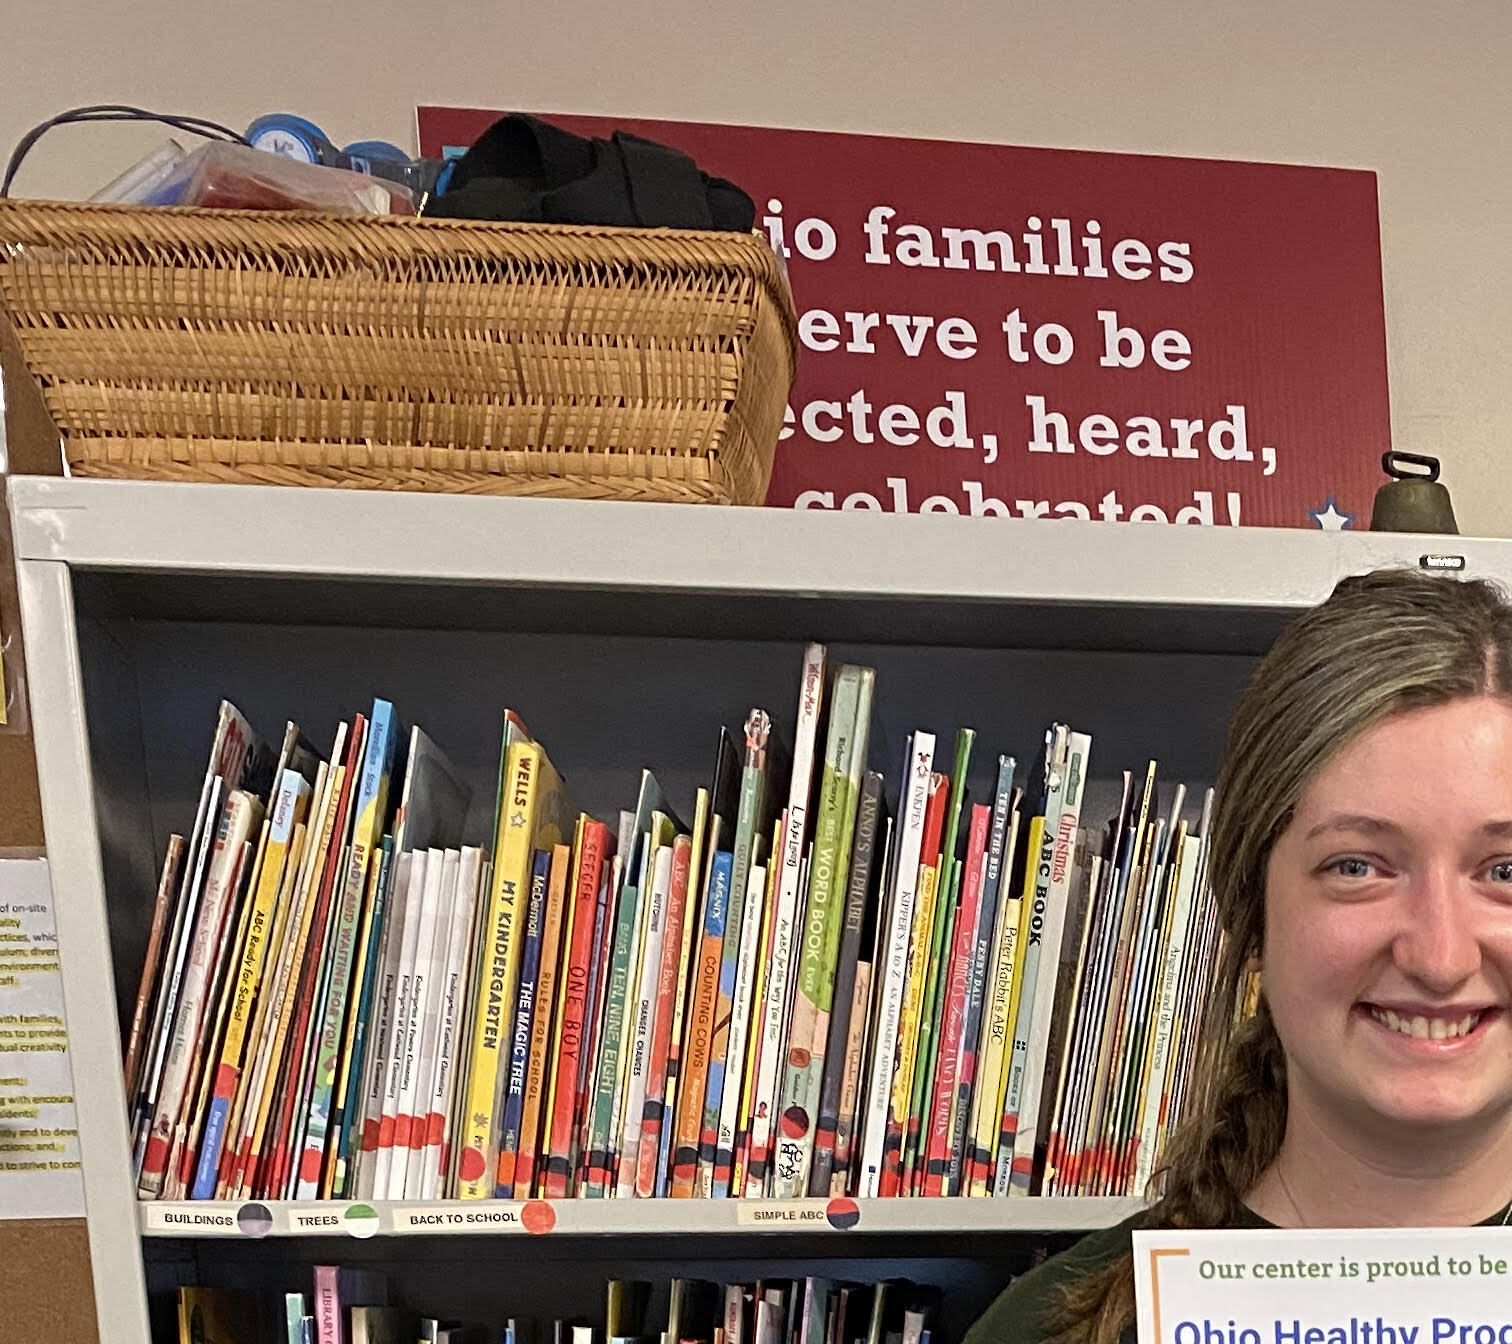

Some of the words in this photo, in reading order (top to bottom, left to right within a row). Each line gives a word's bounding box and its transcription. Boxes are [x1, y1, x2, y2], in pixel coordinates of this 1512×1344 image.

[763, 200, 837, 261] io
[865, 207, 1193, 284] families
[798, 308, 977, 360] erve
[1002, 307, 1073, 365] to
[1098, 311, 1191, 371] be
[778, 390, 999, 464] ected,
[1025, 396, 1277, 476] heard,
[515, 757, 533, 808] WELLS
[1038, 829, 1055, 875] ABC
[1052, 812, 1077, 886] Christmas
[501, 879, 517, 902] MY
[817, 847, 836, 902] WORD
[12, 904, 46, 912] on-site
[1028, 885, 1049, 947] BOOK
[807, 904, 825, 970] BOOK
[483, 906, 512, 1051] KINDERGARTEN
[522, 982, 533, 1008] THE
[570, 965, 586, 1012] ONE
[515, 1006, 531, 1059] MAGIC
[562, 1018, 581, 1061] BOY
[509, 1059, 522, 1096] TREE
[164, 1212, 234, 1226] BUILDINGS
[297, 1214, 339, 1227] TREES
[410, 1214, 441, 1225] BACK
[445, 1214, 465, 1224] TO
[469, 1211, 518, 1224] SCHOOL
[754, 1209, 799, 1221] SIMPLE
[803, 1209, 824, 1221] ABC
[1199, 1260, 1245, 1280] Our
[1252, 1257, 1332, 1279] center
[1340, 1255, 1359, 1277] is
[1367, 1255, 1441, 1283] proud
[1448, 1256, 1471, 1276] to
[1479, 1254, 1507, 1275] be
